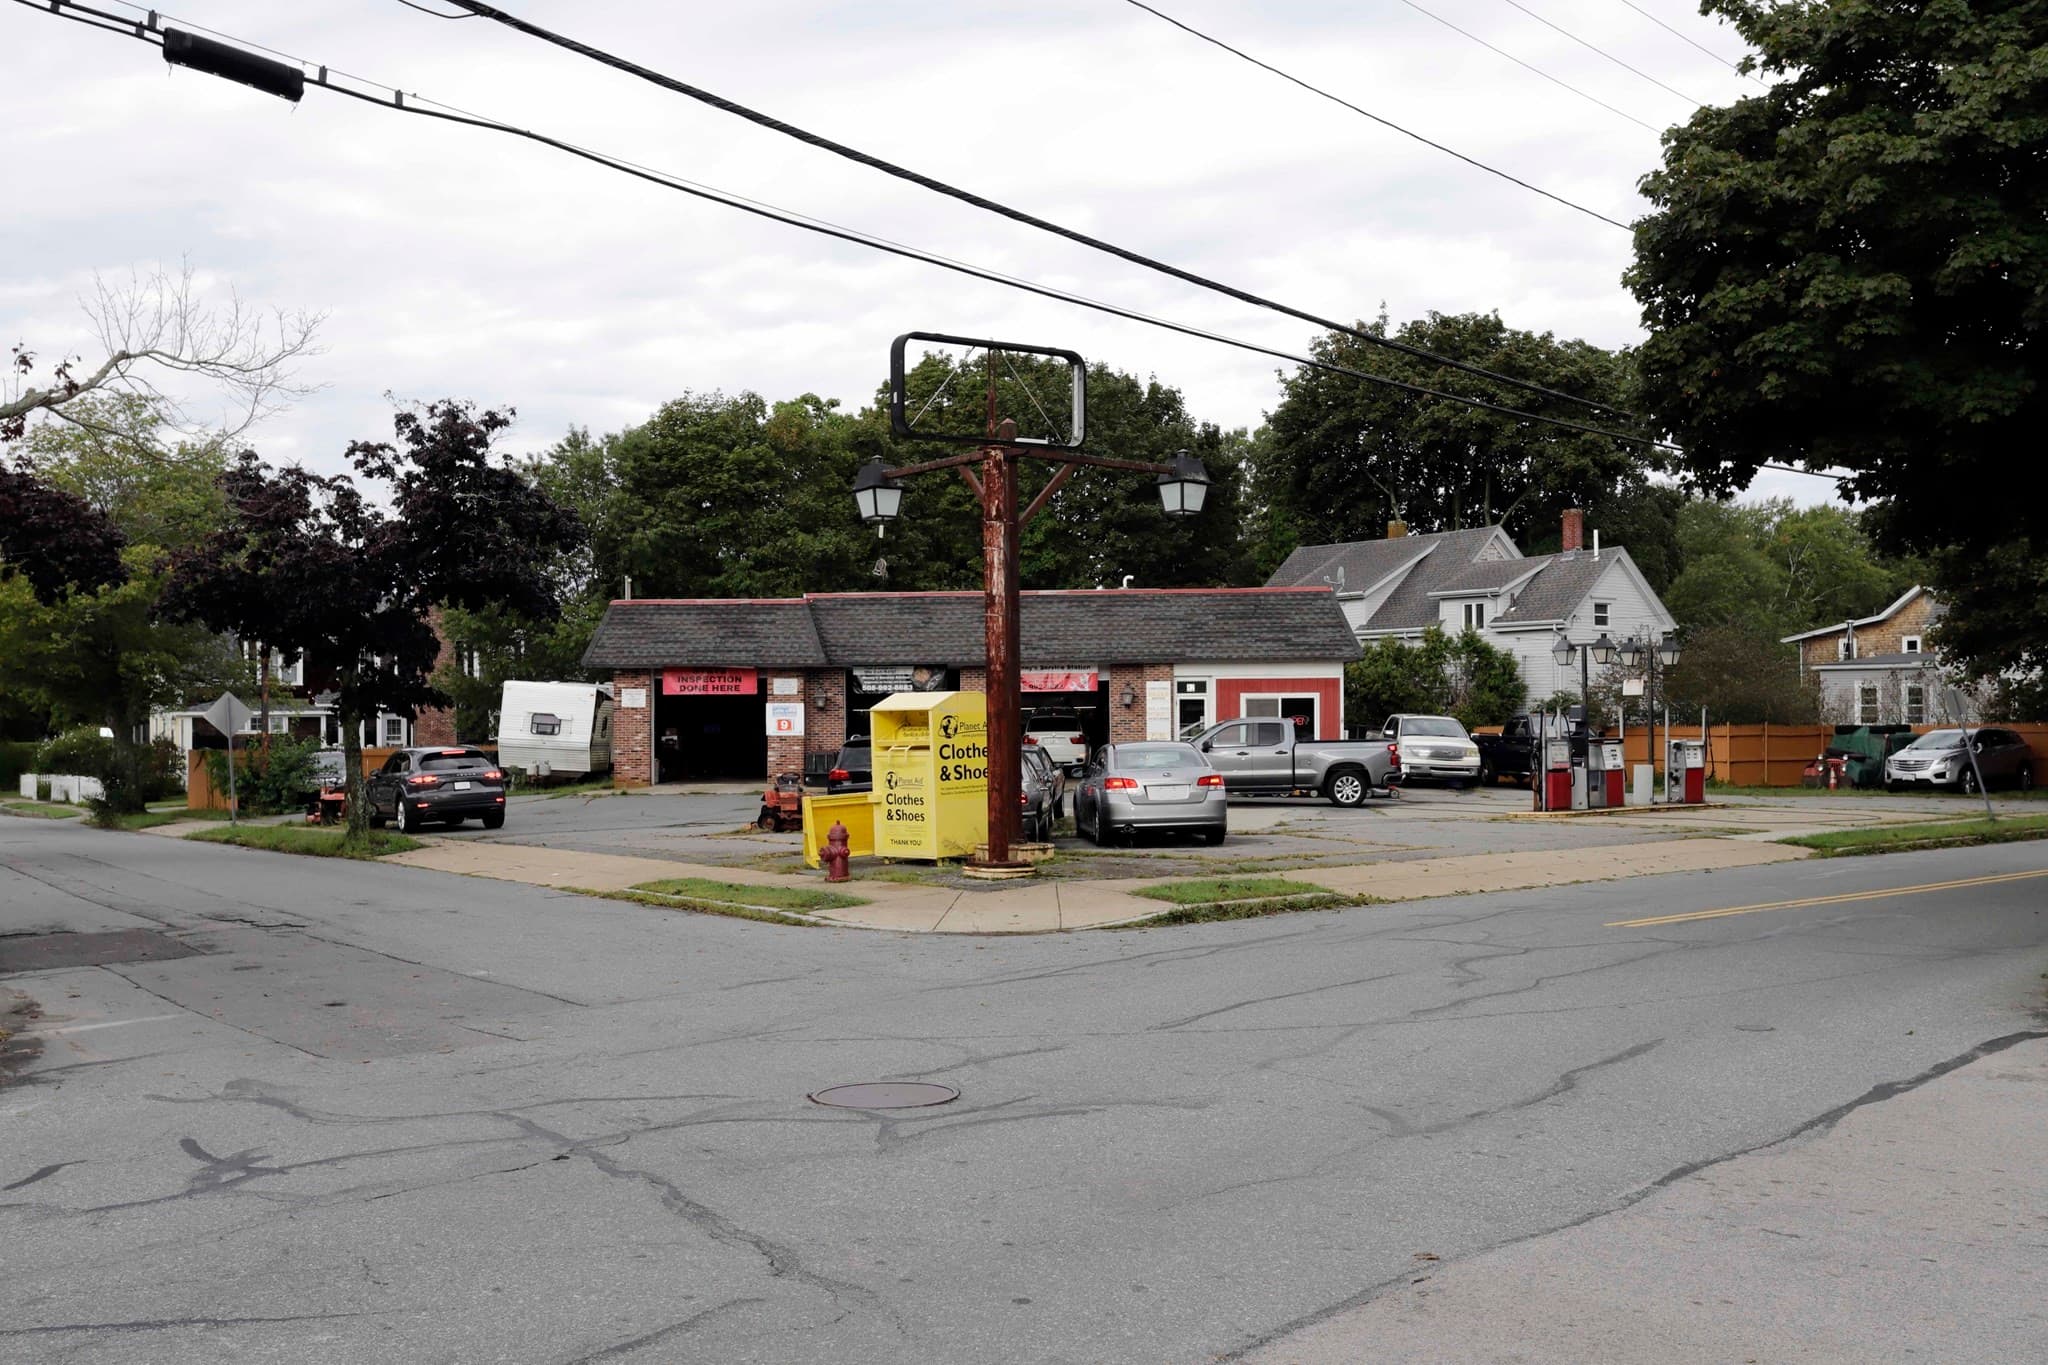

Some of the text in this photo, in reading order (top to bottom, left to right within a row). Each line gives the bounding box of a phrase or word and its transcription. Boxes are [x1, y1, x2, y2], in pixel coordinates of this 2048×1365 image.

[780, 720, 788, 730] 9
[960, 722, 980, 731] Planet
[939, 743, 988, 760] Clothe
[940, 764, 988, 781] & Shoe
[886, 793, 924, 806] Clothes
[886, 809, 925, 822] & Shoes
